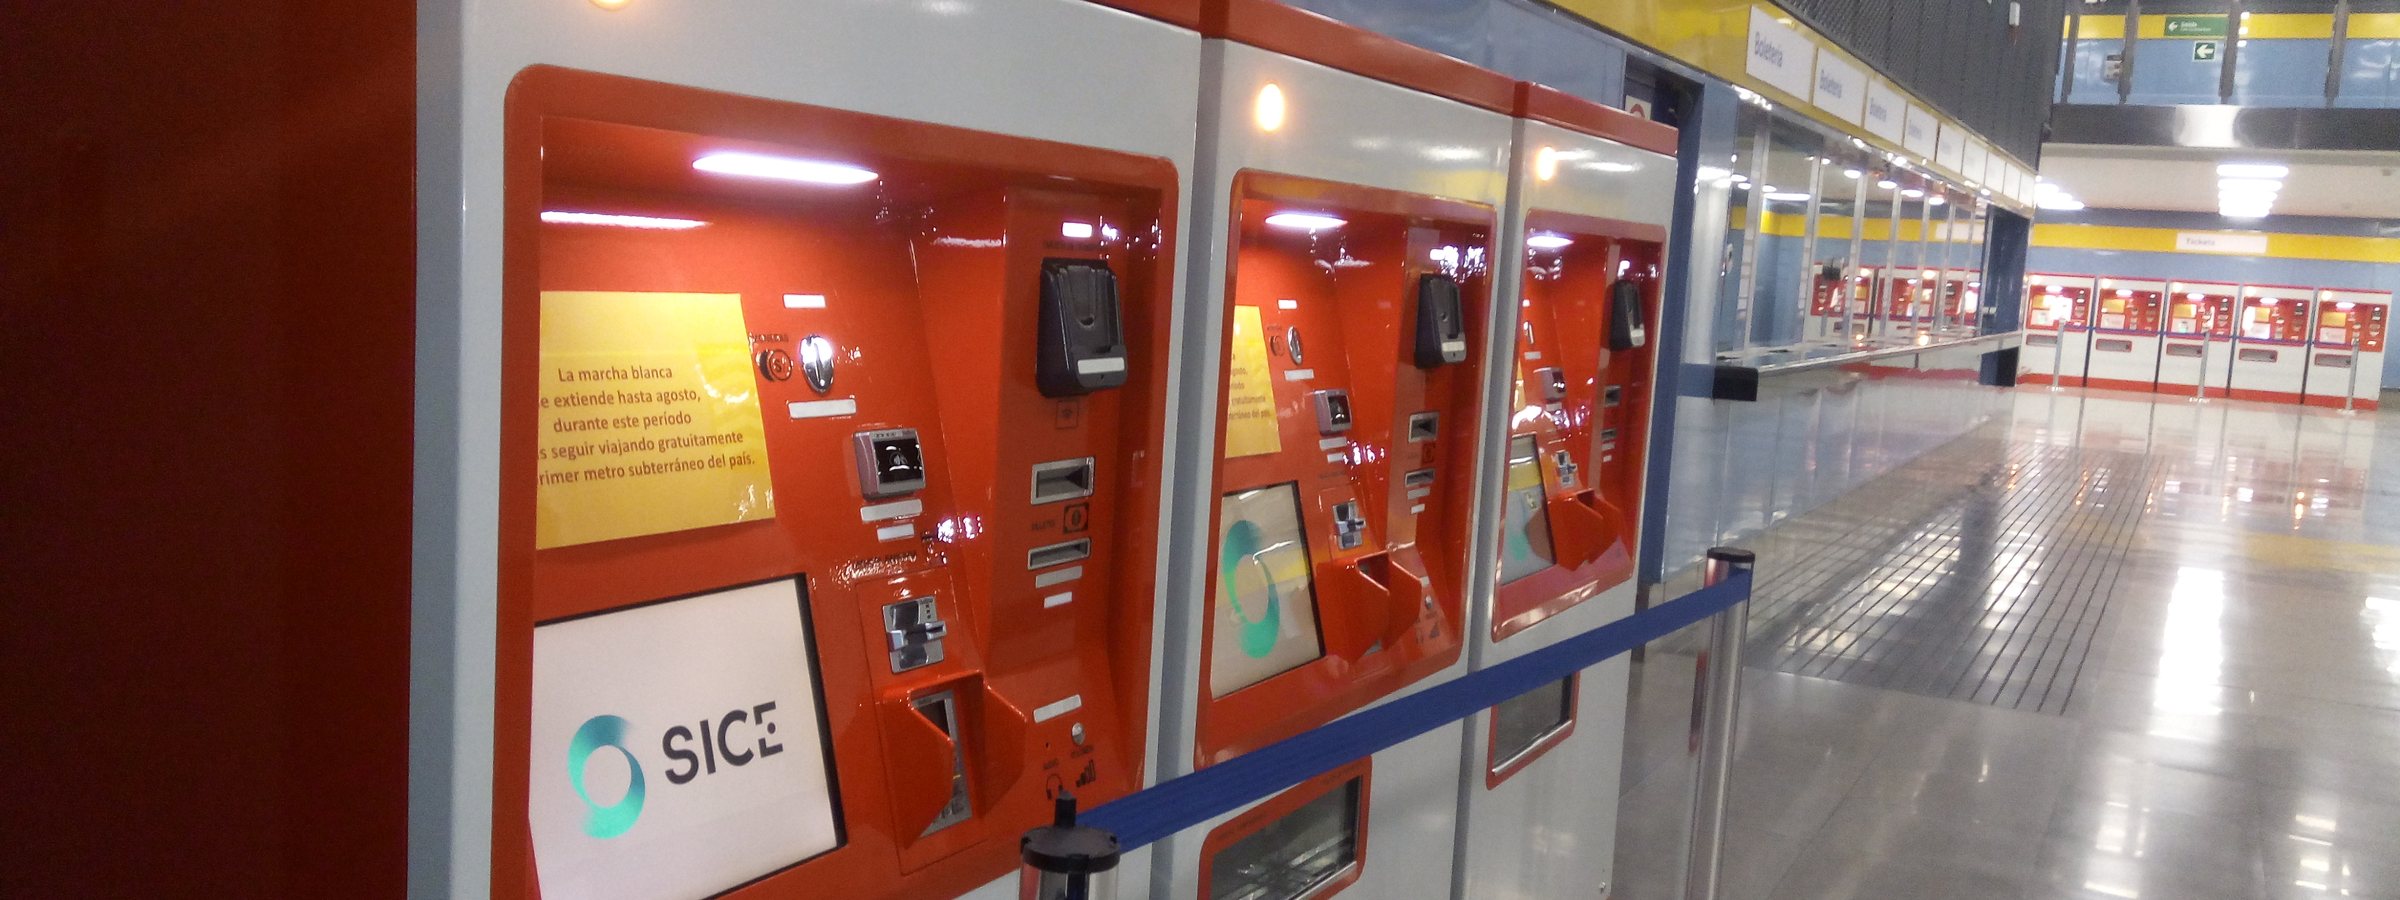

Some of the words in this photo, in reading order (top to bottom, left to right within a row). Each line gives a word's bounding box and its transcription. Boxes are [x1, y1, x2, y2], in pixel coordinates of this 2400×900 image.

[558, 367, 575, 383] La
[578, 365, 628, 381] marcha
[631, 364, 673, 380] blanca
[539, 396, 550, 409] e
[553, 391, 615, 408] extiende
[617, 389, 653, 405] hasta
[656, 388, 701, 406] agosto,
[553, 417, 609, 433] durante
[612, 415, 640, 430] este
[539, 446, 548, 460] s
[550, 441, 595, 461] seguir
[598, 437, 655, 456] viajando
[657, 432, 744, 454] gratuitamente
[539, 470, 580, 486] rimer
[583, 465, 626, 481] metro
[628, 457, 705, 477] subterráneo
[707, 453, 727, 469] del
[729, 450, 756, 470] país.
[662, 700, 784, 785] SICE
